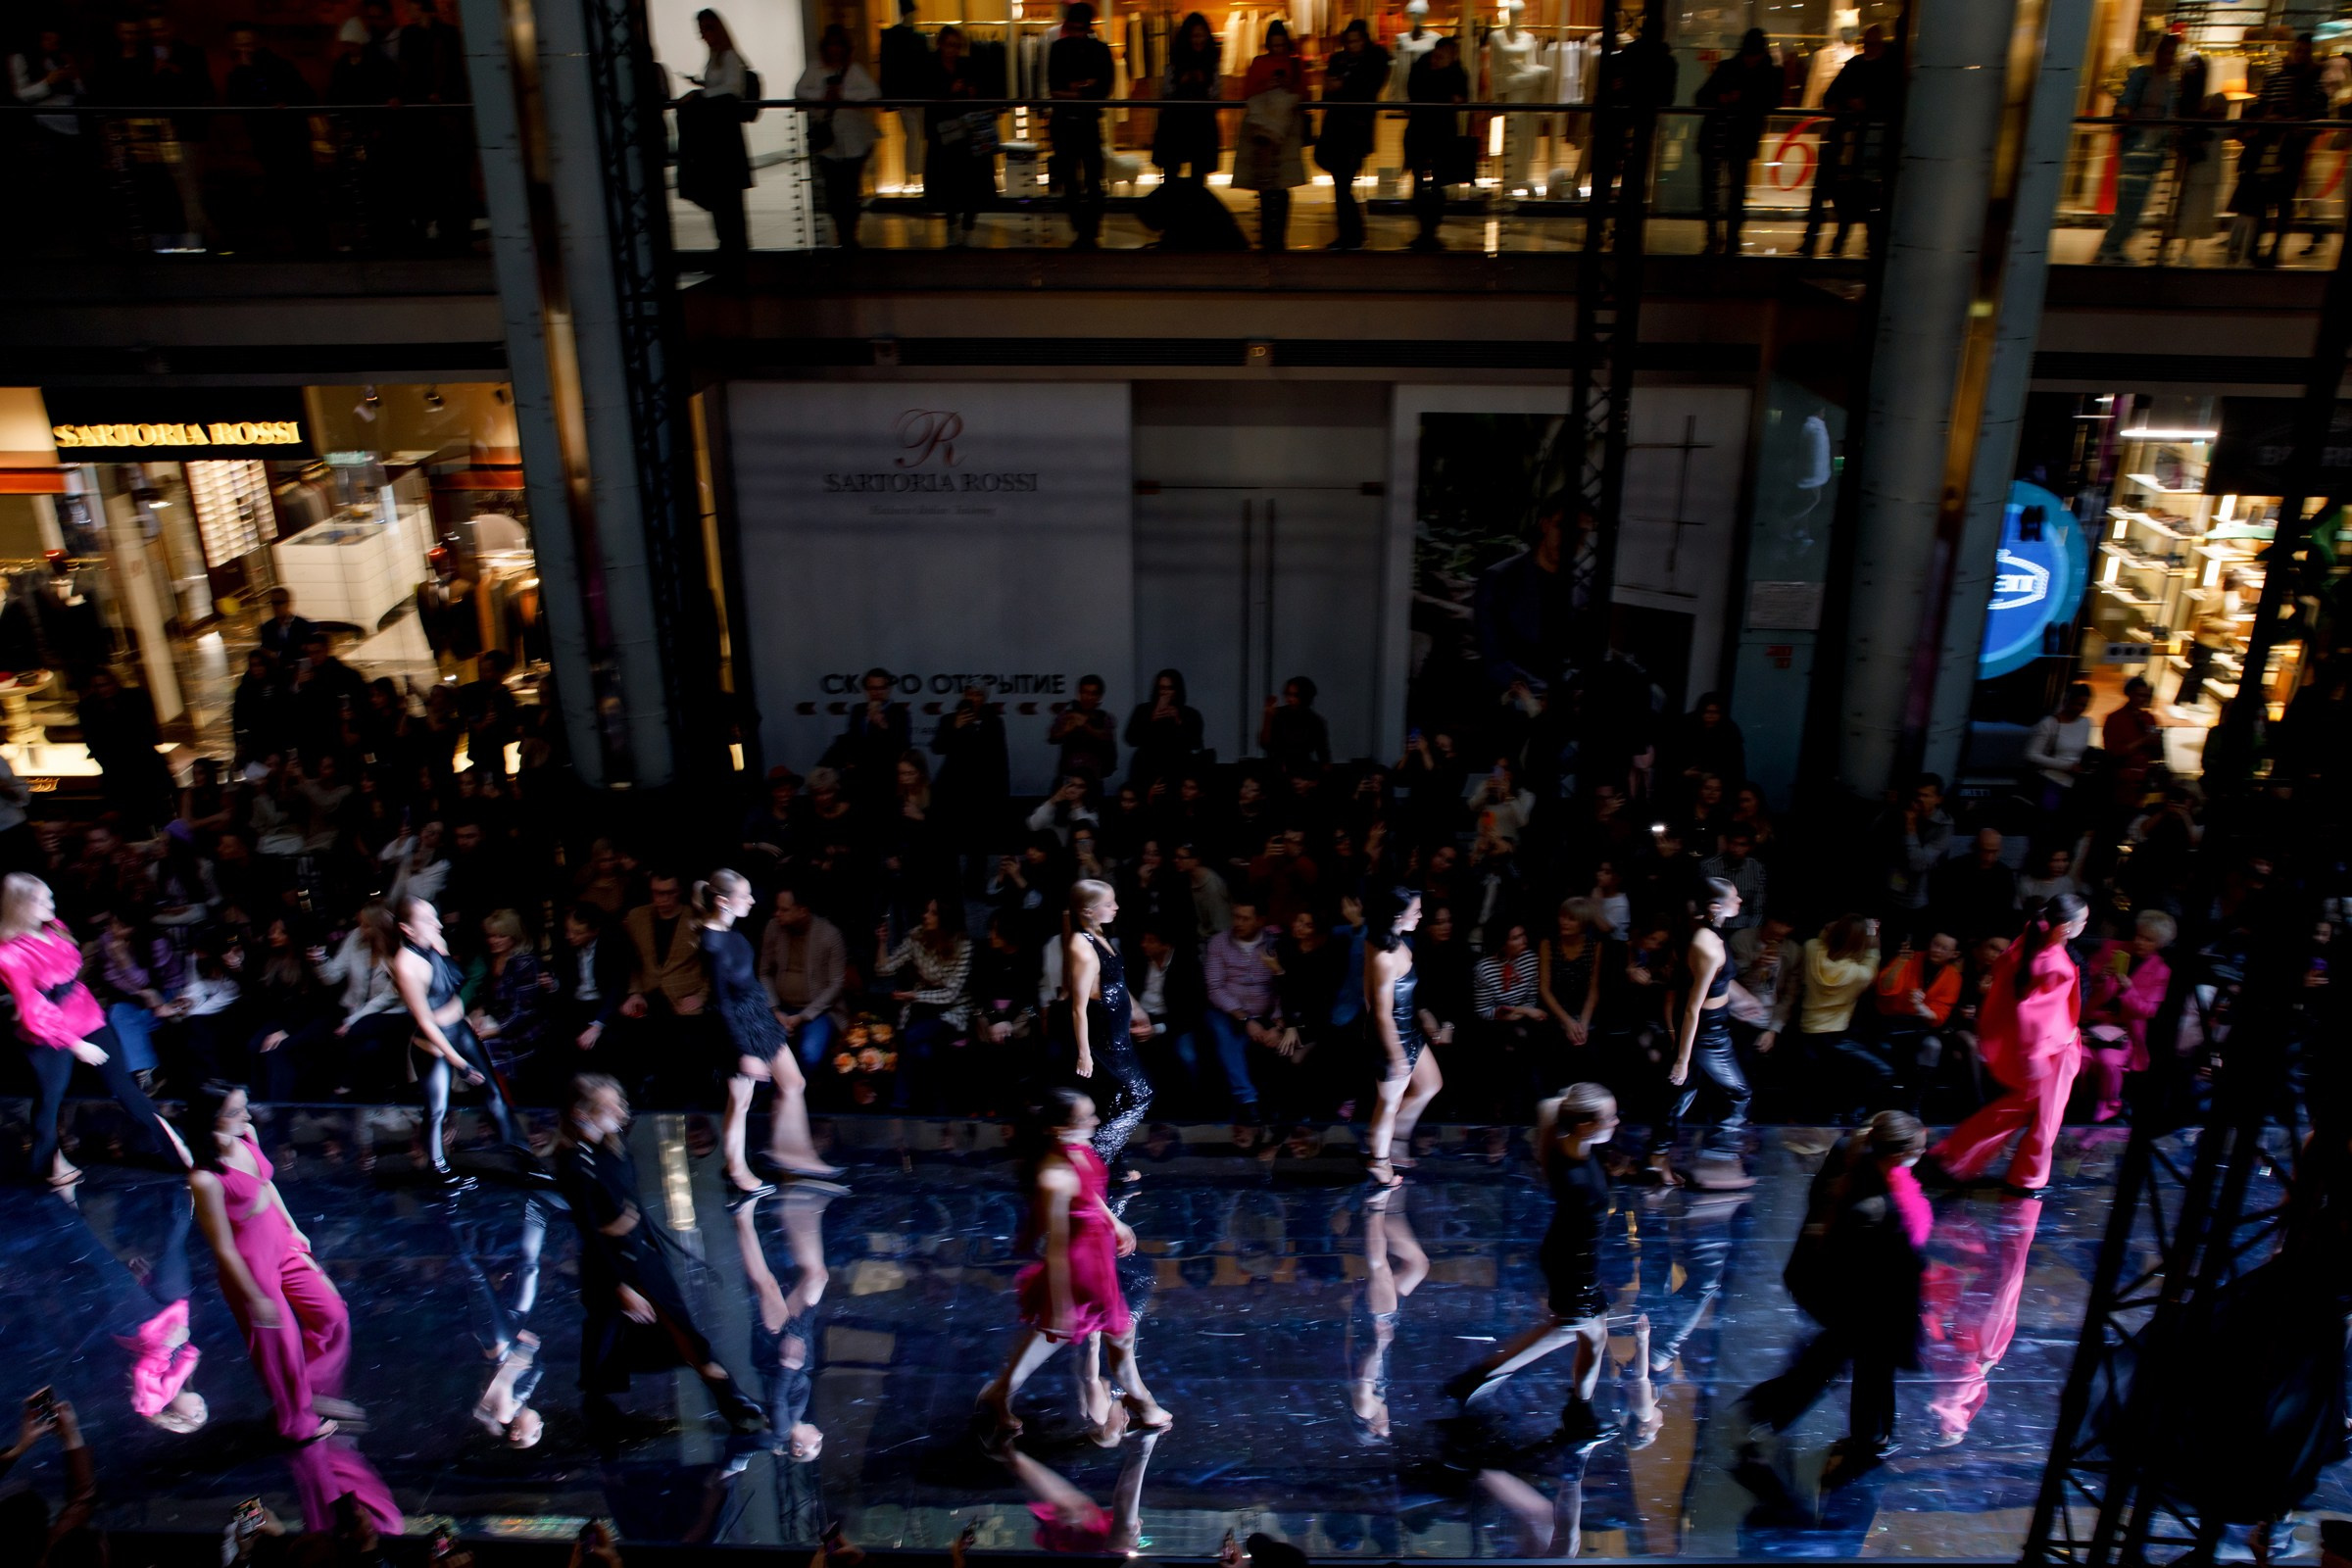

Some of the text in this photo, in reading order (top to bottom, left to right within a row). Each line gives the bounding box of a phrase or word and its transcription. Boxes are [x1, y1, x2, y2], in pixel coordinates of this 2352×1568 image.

[53, 420, 303, 448] SARTORIA ROSSI
[891, 408, 968, 468] R
[824, 472, 1038, 493] SARTORIA ROSSI
[821, 673, 922, 695] СКРО
